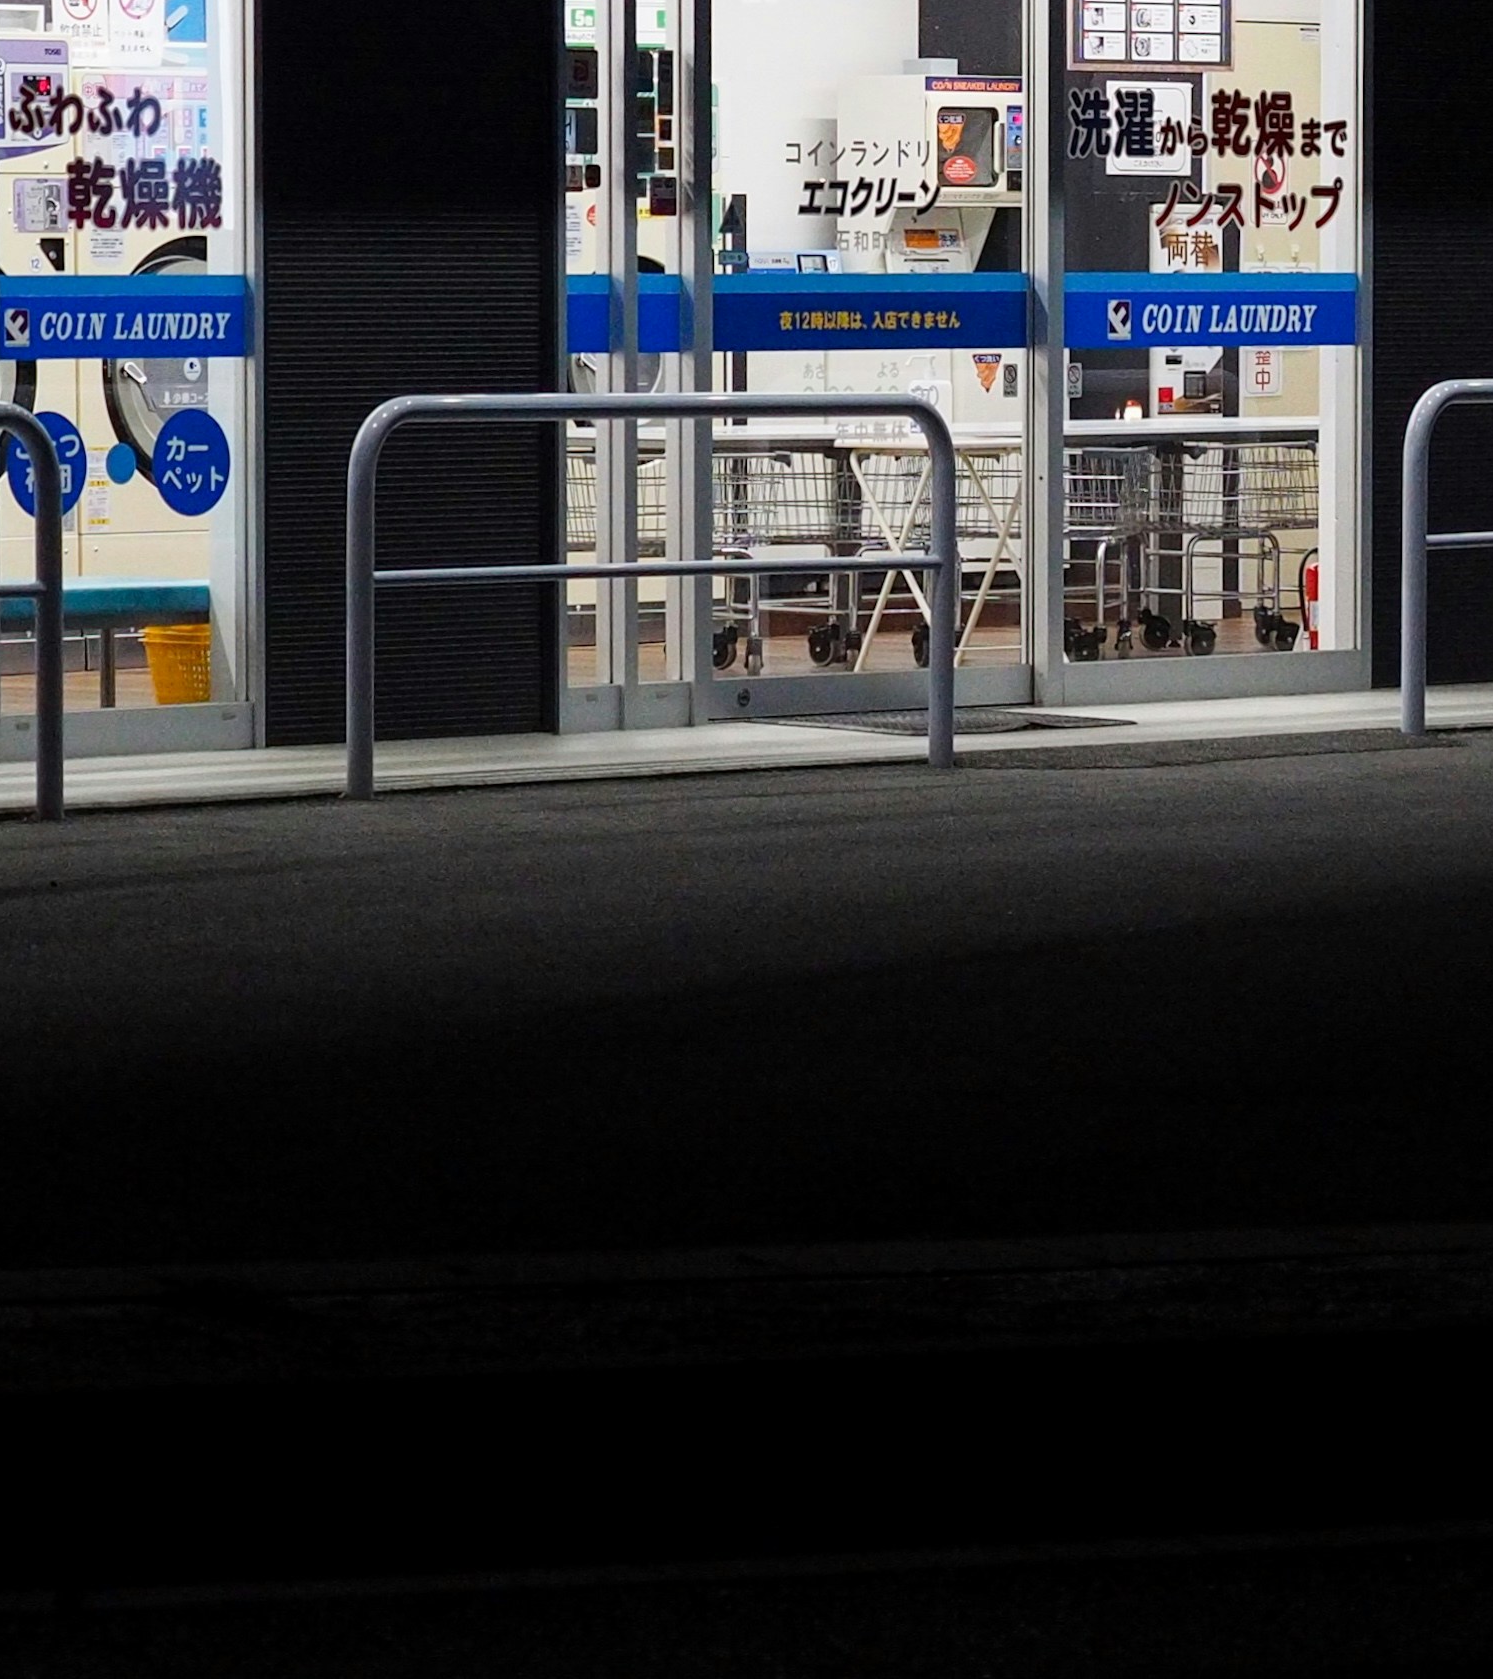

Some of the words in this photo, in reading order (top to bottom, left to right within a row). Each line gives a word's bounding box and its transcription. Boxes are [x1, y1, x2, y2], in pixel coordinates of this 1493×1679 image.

[44, 48, 62, 56] TOSEI
[987, 81, 1020, 92] LAUNDRY
[8, 85, 162, 138] ふわふわ
[1067, 86, 1348, 159] 洗濯から乾燥まで
[66, 156, 223, 230] 乾燥機
[797, 176, 943, 219] エコクリーン
[1154, 177, 1344, 231] ノンストップ
[835, 230, 904, 255] 石和町
[1165, 231, 1216, 267] 両替
[30, 258, 41, 269] 12
[39, 312, 107, 340] COIN
[113, 312, 232, 341] LAUNDRY
[778, 310, 961, 331] 夜12時以降は、入店できません
[1141, 303, 1203, 334] COIN
[1208, 304, 1318, 334] LAUNDRY
[876, 361, 900, 379] よる
[835, 421, 906, 444] 年中無休
[166, 435, 209, 462] カー
[162, 467, 226, 495] ペット
